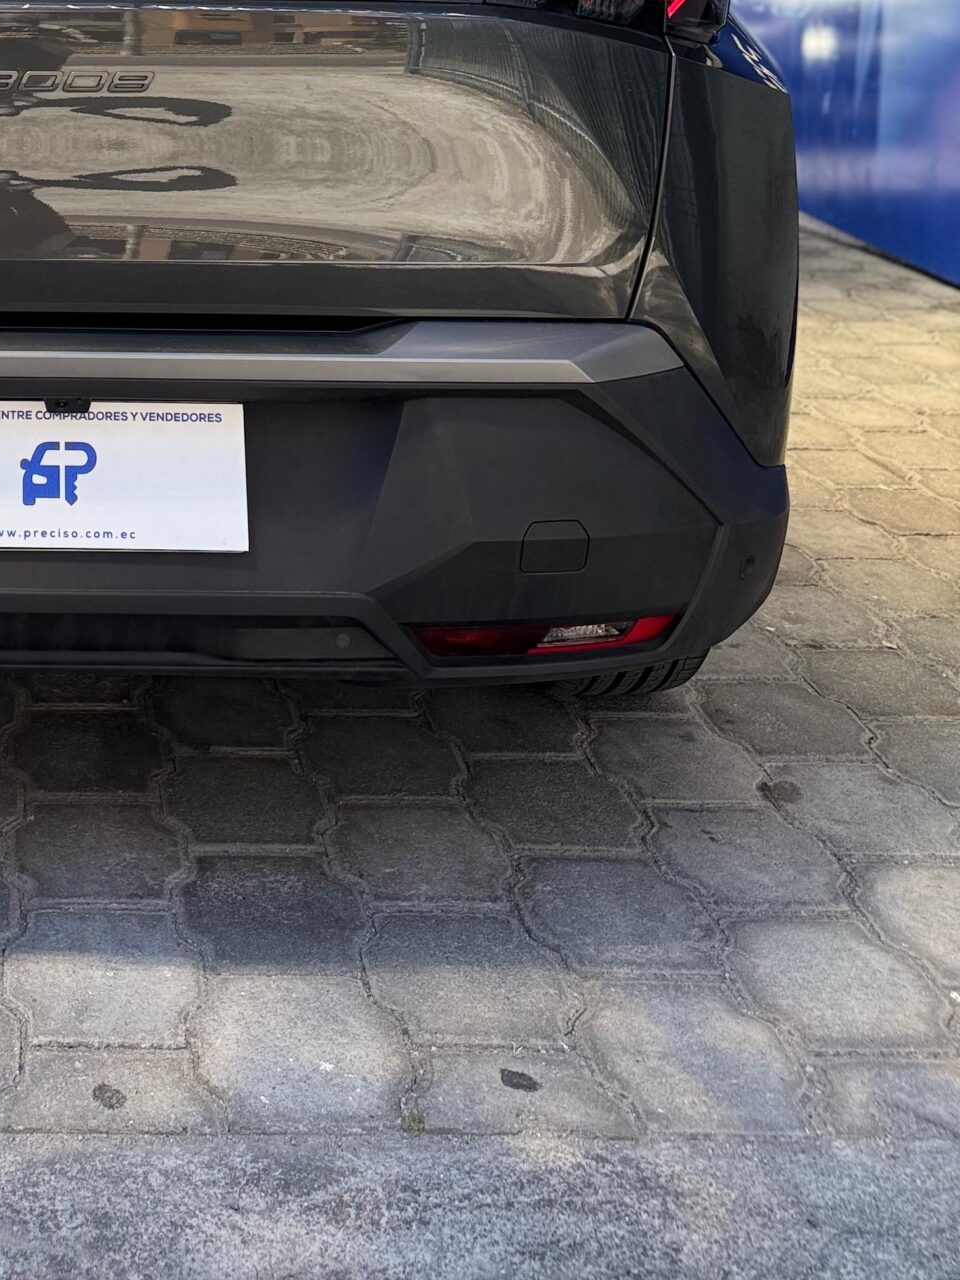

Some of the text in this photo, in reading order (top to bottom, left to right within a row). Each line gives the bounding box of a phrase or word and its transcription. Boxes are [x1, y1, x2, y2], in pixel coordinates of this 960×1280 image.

[35, 410, 128, 421] COMPRADORES
[130, 411, 139, 421] Y
[140, 412, 222, 423] VENDEDORES
